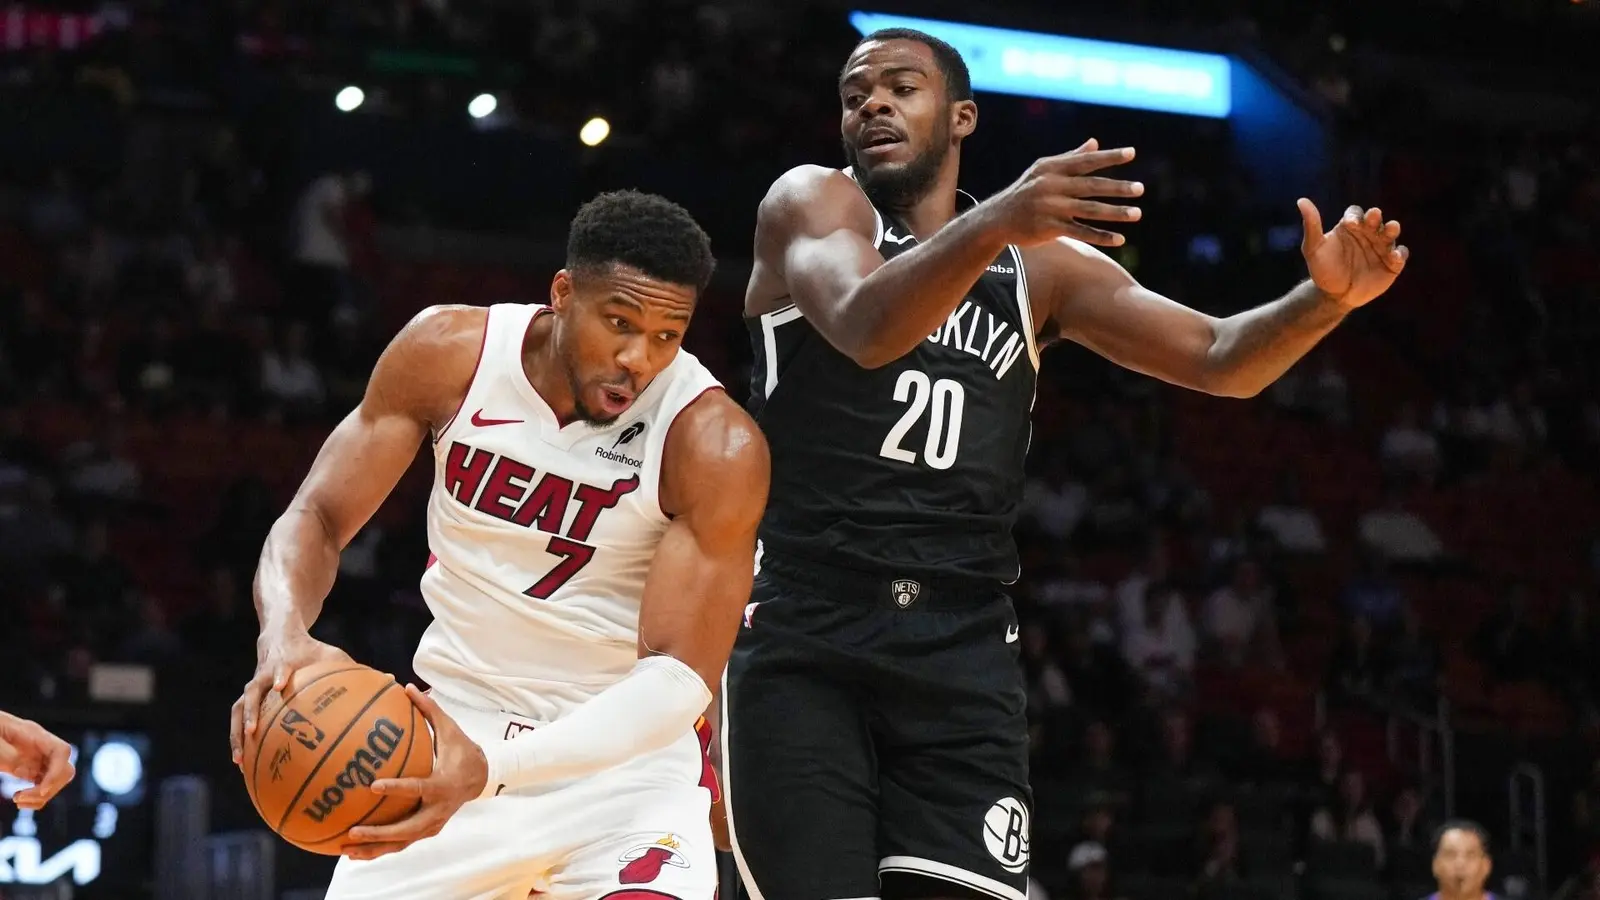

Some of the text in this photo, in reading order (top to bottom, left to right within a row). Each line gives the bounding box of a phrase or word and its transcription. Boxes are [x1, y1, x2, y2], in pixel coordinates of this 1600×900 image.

[879, 369, 965, 470] 20
[445, 441, 640, 542] HEAT
[522, 535, 597, 600] 7
[894, 582, 918, 594] NETS
[303, 718, 405, 823] Wilson
